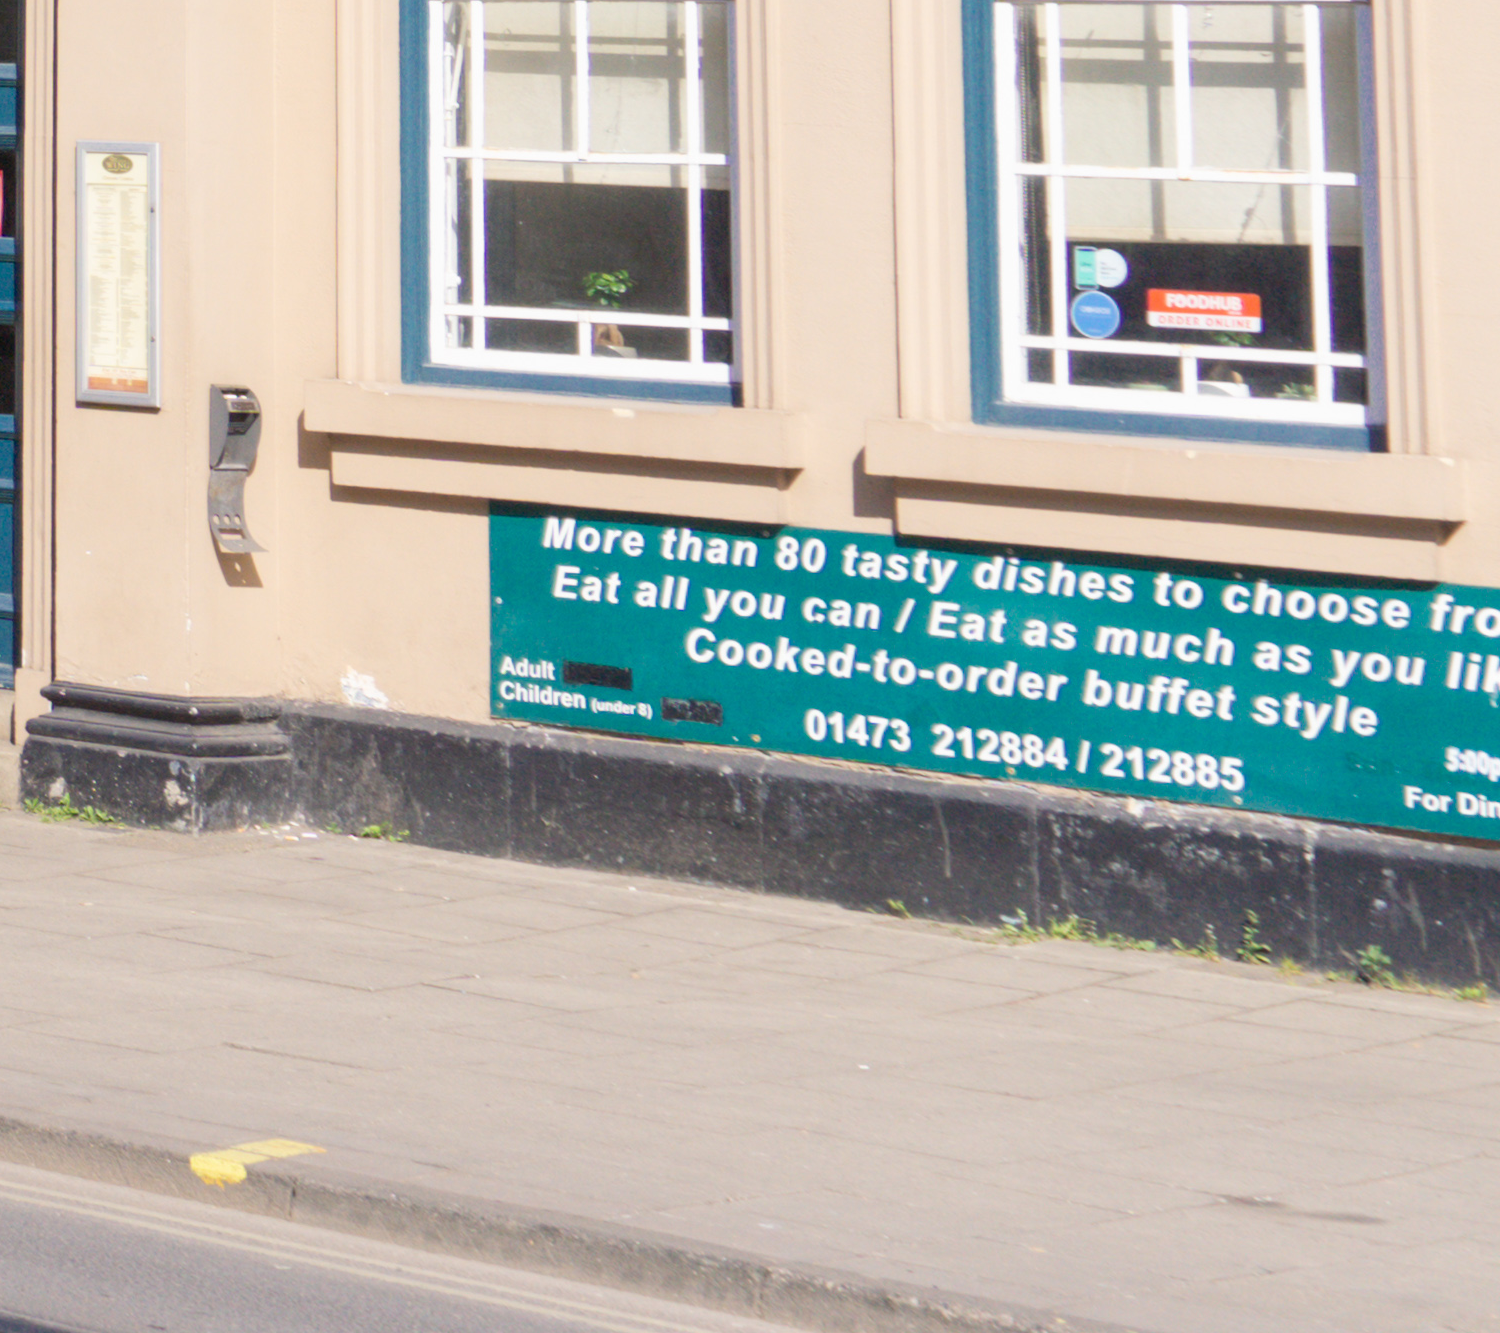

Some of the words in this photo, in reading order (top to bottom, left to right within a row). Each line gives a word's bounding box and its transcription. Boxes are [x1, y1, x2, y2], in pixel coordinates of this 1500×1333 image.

[1164, 292, 1243, 311] FOODHUB
[1158, 314, 1201, 326] ORDER
[1205, 316, 1253, 330] ONLINE
[541, 517, 645, 557] More
[661, 528, 758, 568] than
[775, 538, 827, 573] 80
[842, 544, 958, 594] tasty
[972, 557, 1135, 603] dishes
[1153, 573, 1204, 610] to
[1221, 578, 1411, 630] choose
[552, 565, 622, 605] Eat
[634, 576, 690, 611] all
[701, 587, 786, 622] you
[802, 596, 881, 630] can
[893, 598, 917, 633] /
[926, 601, 1007, 644] Eat
[1022, 619, 1079, 651] as
[1096, 625, 1236, 666] much
[1252, 641, 1313, 675] as
[1329, 649, 1426, 688] you
[500, 656, 556, 681] Adult
[685, 627, 1068, 702] Cooked-to-order
[1082, 669, 1237, 721] buffet
[1250, 693, 1379, 740] style
[500, 681, 587, 709] Children
[590, 697, 636, 716] (under
[637, 702, 654, 721] 8)
[804, 707, 911, 752] 01473
[932, 724, 1069, 771] 212884
[1099, 742, 1245, 793] 212885
[1403, 785, 1453, 813] For
